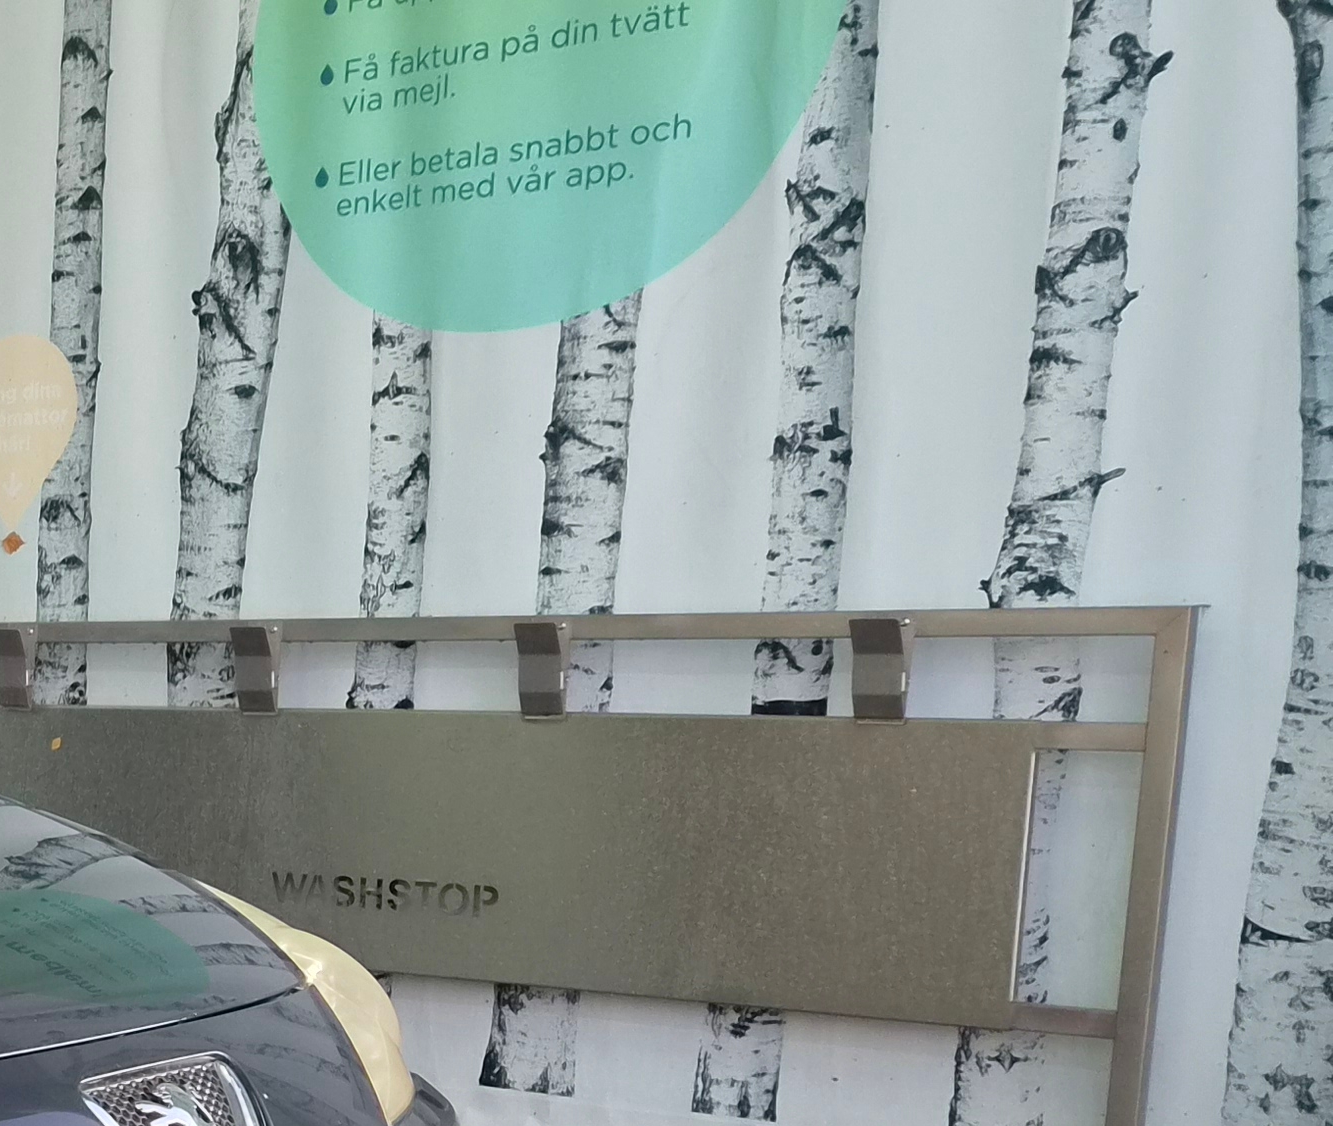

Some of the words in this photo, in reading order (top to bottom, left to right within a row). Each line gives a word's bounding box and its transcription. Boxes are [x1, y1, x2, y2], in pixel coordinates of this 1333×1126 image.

[343, 53, 380, 84] Få
[390, 41, 490, 77] faktura
[500, 24, 540, 62] på
[551, 19, 599, 49] din
[610, 2, 691, 39] tvätt
[342, 88, 383, 115] via
[393, 73, 457, 107] mejl.
[338, 158, 402, 187] Eller
[410, 141, 499, 177] betala
[509, 123, 619, 163] snabbt
[630, 113, 693, 145] och
[336, 185, 423, 217] enkelt
[432, 172, 496, 206] med
[507, 164, 557, 196] vår
[565, 160, 635, 191] app.
[271, 870, 500, 919] WASHSTOP
